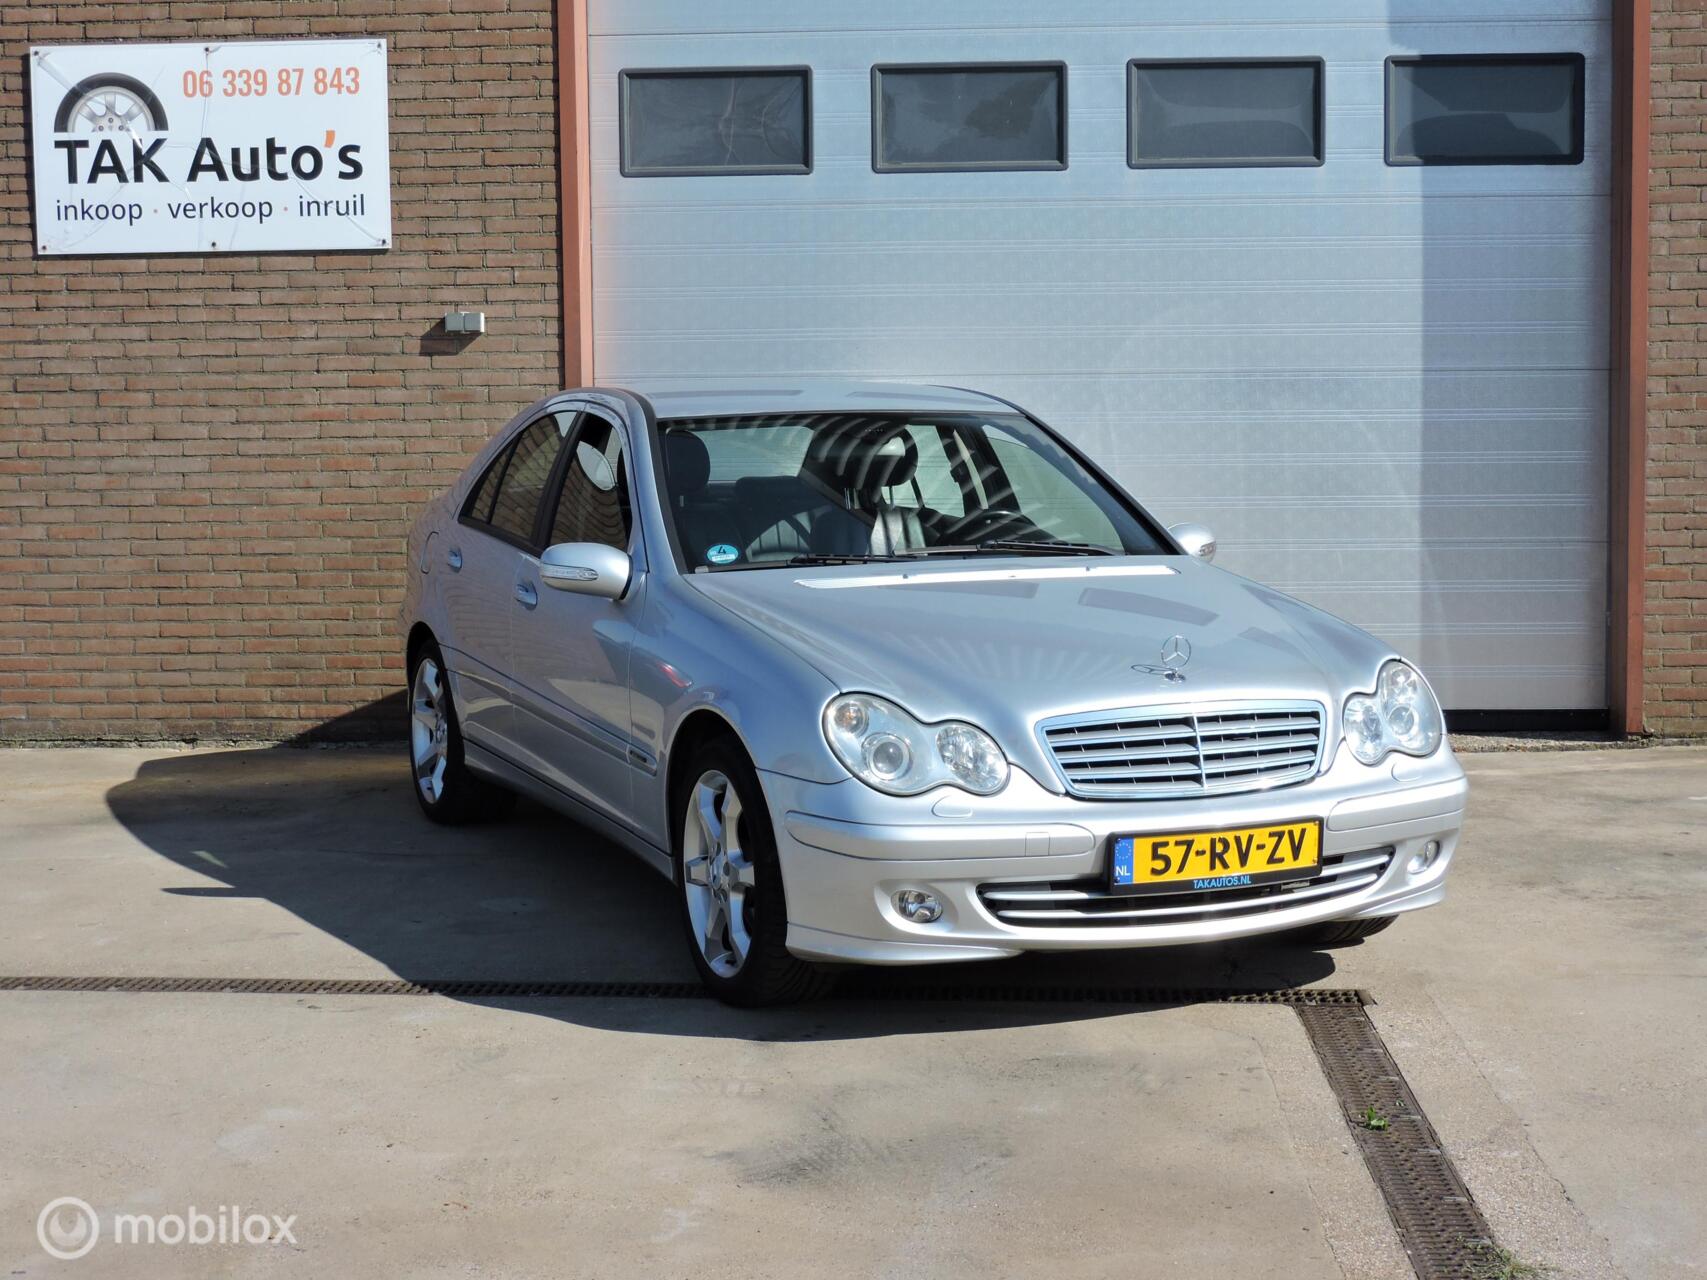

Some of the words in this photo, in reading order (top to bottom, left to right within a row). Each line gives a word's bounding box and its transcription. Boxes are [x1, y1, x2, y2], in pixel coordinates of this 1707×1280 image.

[182, 70, 214, 98] 06
[222, 69, 268, 97] 339
[277, 68, 305, 96] 87
[313, 66, 361, 95] 843
[54, 137, 170, 184] TAK
[186, 129, 364, 183] Auto's
[56, 198, 143, 226] inkoop
[167, 196, 273, 224] verkoop
[298, 193, 366, 217] inruil
[1150, 827, 1307, 877] 57-RV-ZV
[1115, 865, 1131, 877] NL
[1193, 875, 1252, 889] TAKAUTOS.NL
